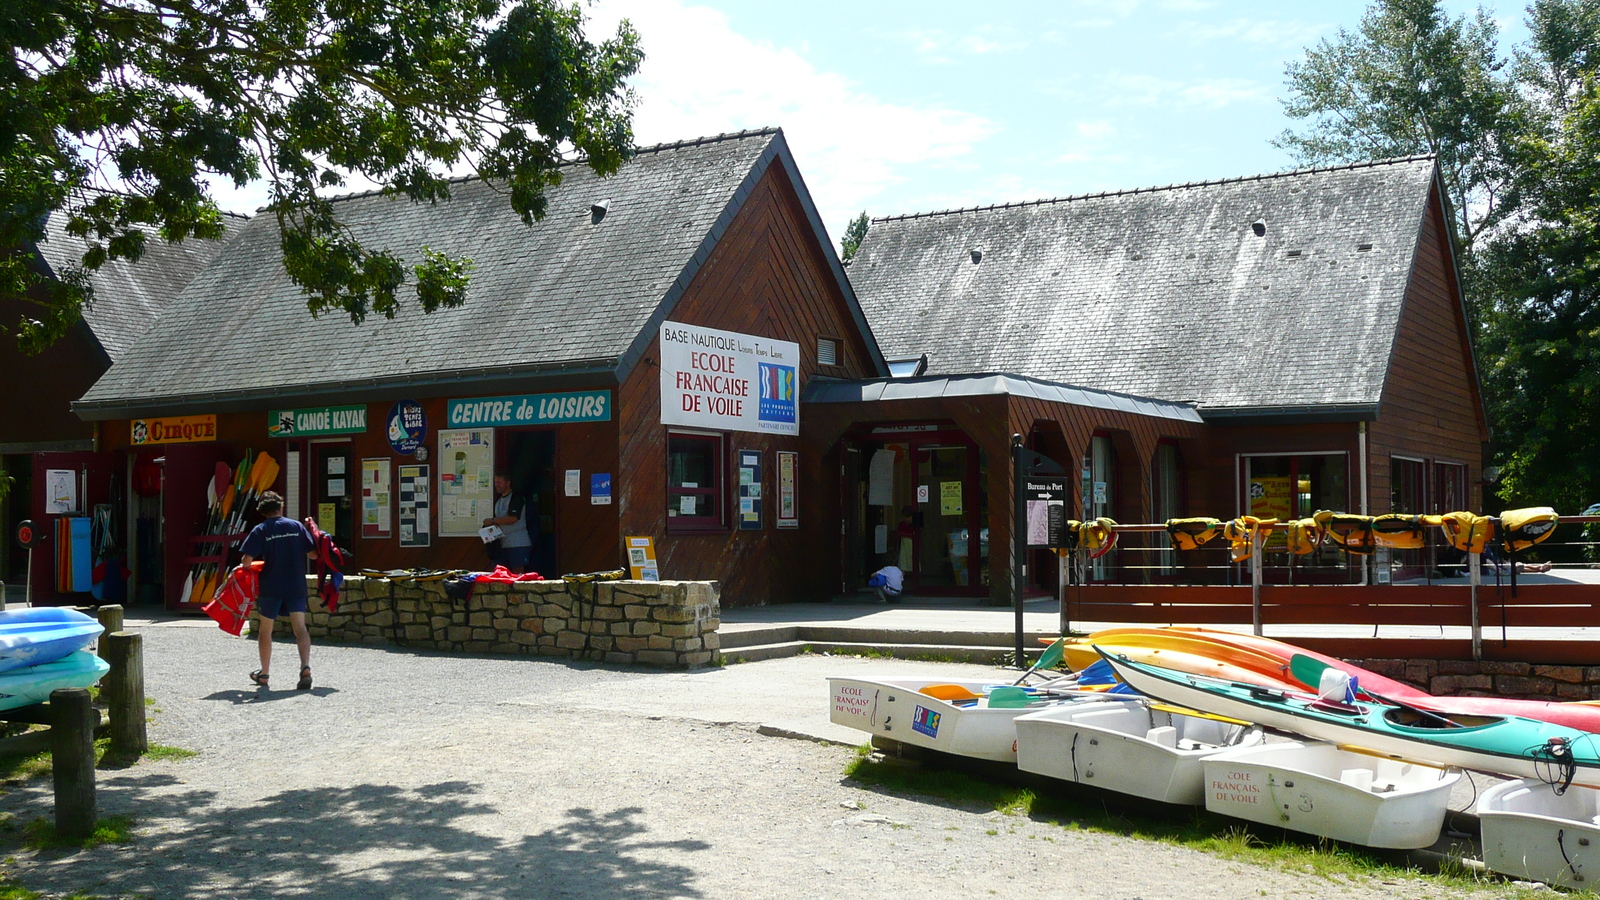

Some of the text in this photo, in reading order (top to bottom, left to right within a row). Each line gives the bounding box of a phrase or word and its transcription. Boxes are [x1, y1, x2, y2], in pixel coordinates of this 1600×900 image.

[664, 328, 688, 344] BASE
[691, 333, 735, 351] NAUTIQUE
[691, 352, 735, 374] ECOLE
[676, 371, 748, 397] FRANCAISE
[452, 395, 605, 424] CENTRE de LOISIRS
[682, 394, 742, 417] DE VOILE
[297, 408, 365, 431] CANOÉ KAYAK
[841, 687, 862, 696] ECOLE
[1212, 781, 1260, 793] FRANÇAIS
[1216, 792, 1258, 804] DE VOILE
